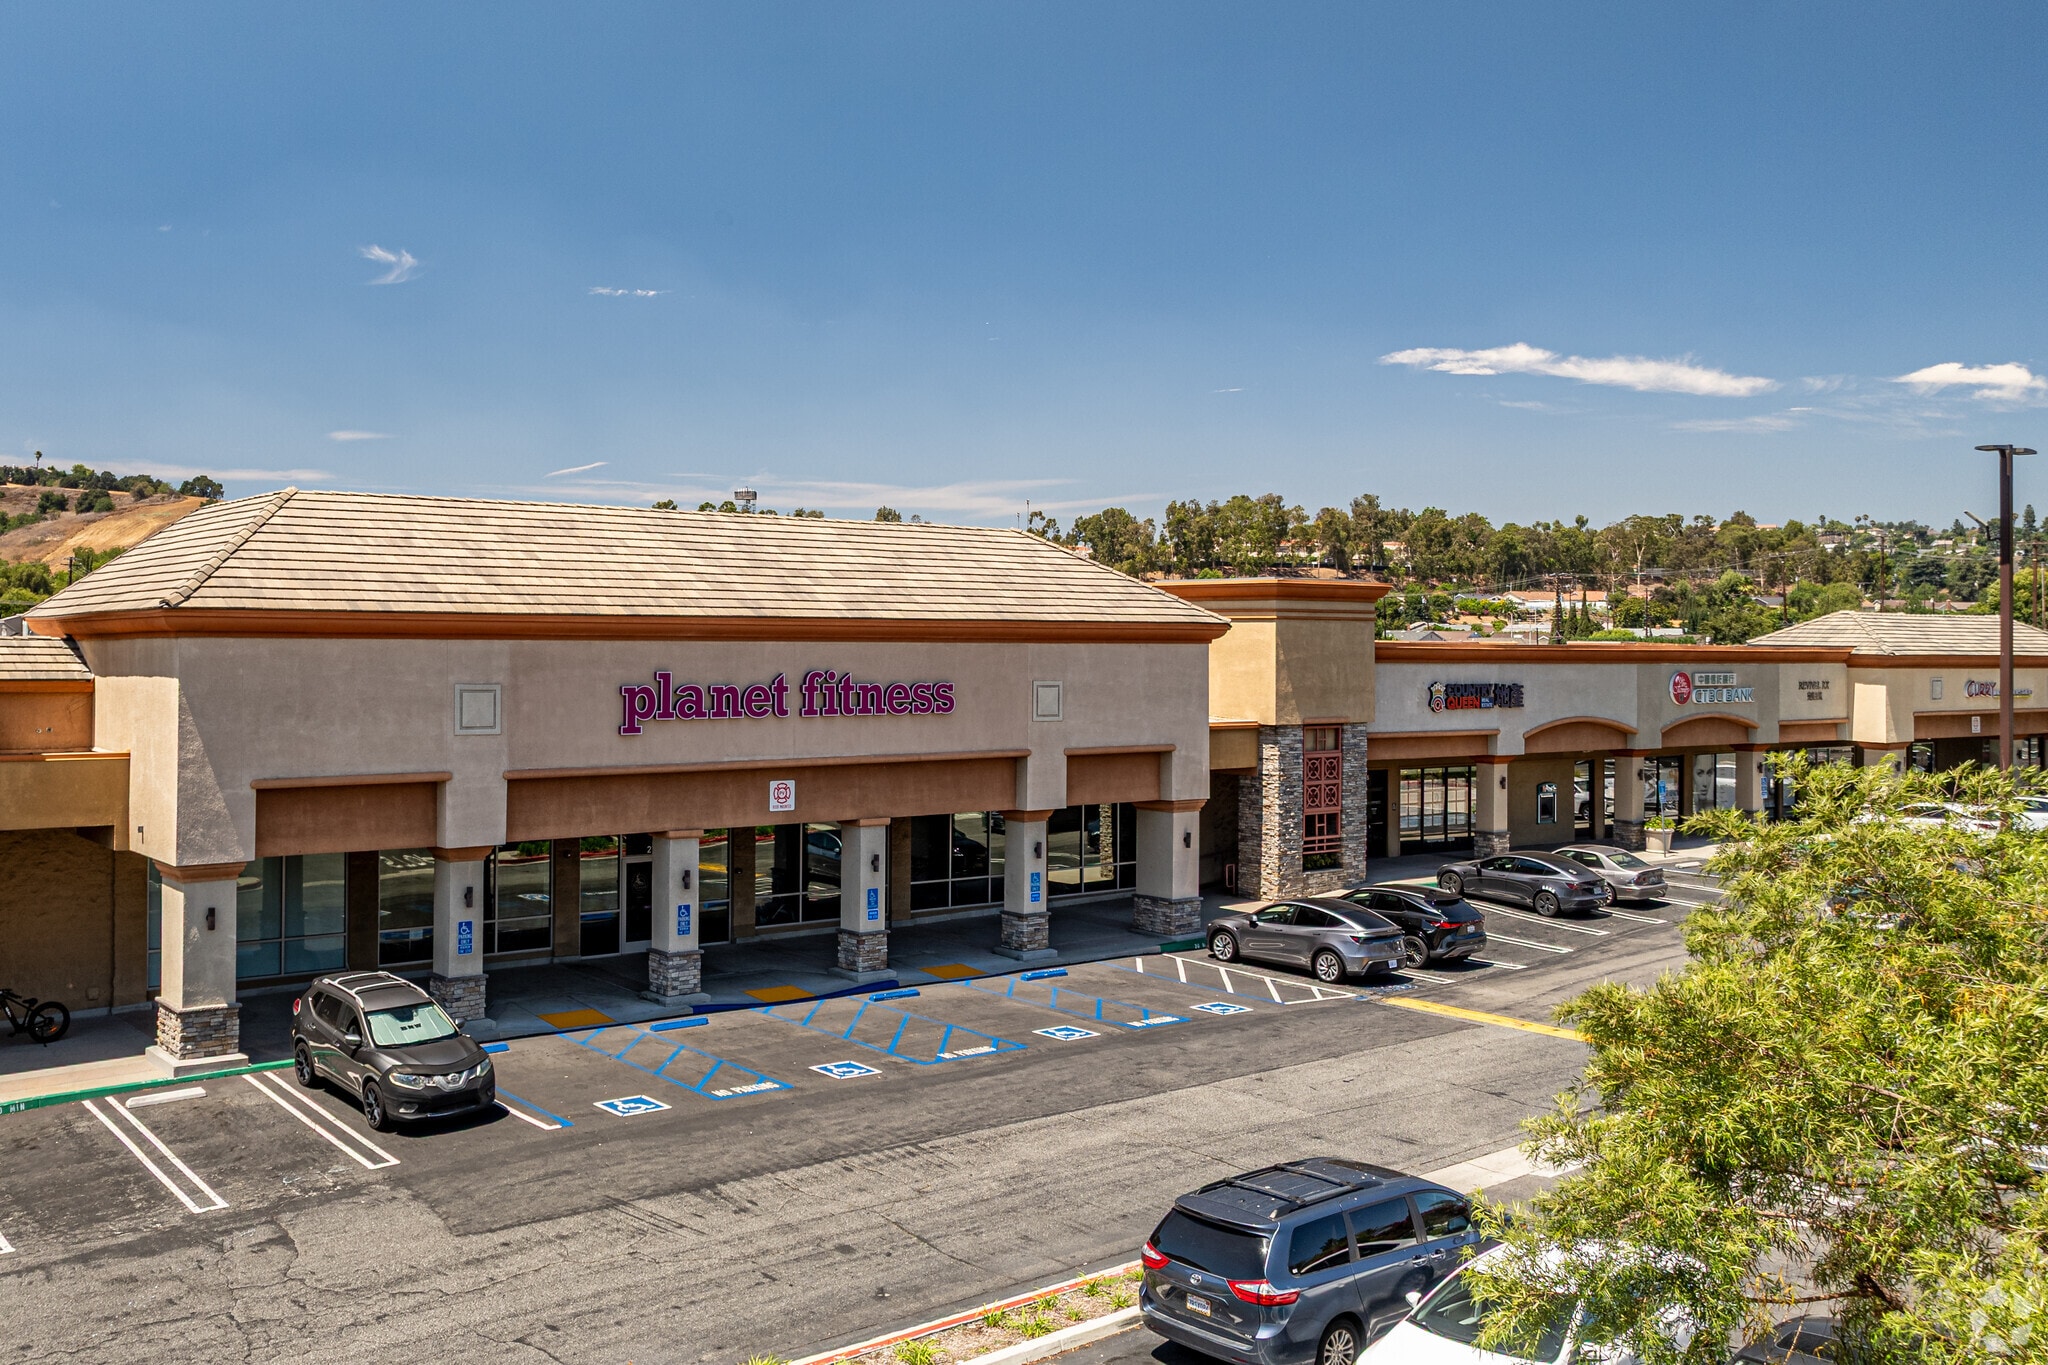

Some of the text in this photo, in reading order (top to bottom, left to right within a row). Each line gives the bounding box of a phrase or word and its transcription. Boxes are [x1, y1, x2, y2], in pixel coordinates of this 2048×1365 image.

[1445, 683, 1494, 697] COUNTRY
[1693, 688, 1755, 703] CTBC BANK
[619, 669, 957, 736] planet fitness
[1446, 696, 1481, 710] QUEEN
[711, 1081, 780, 1097] NO PARKING
[9, 1102, 25, 1113] MIN
